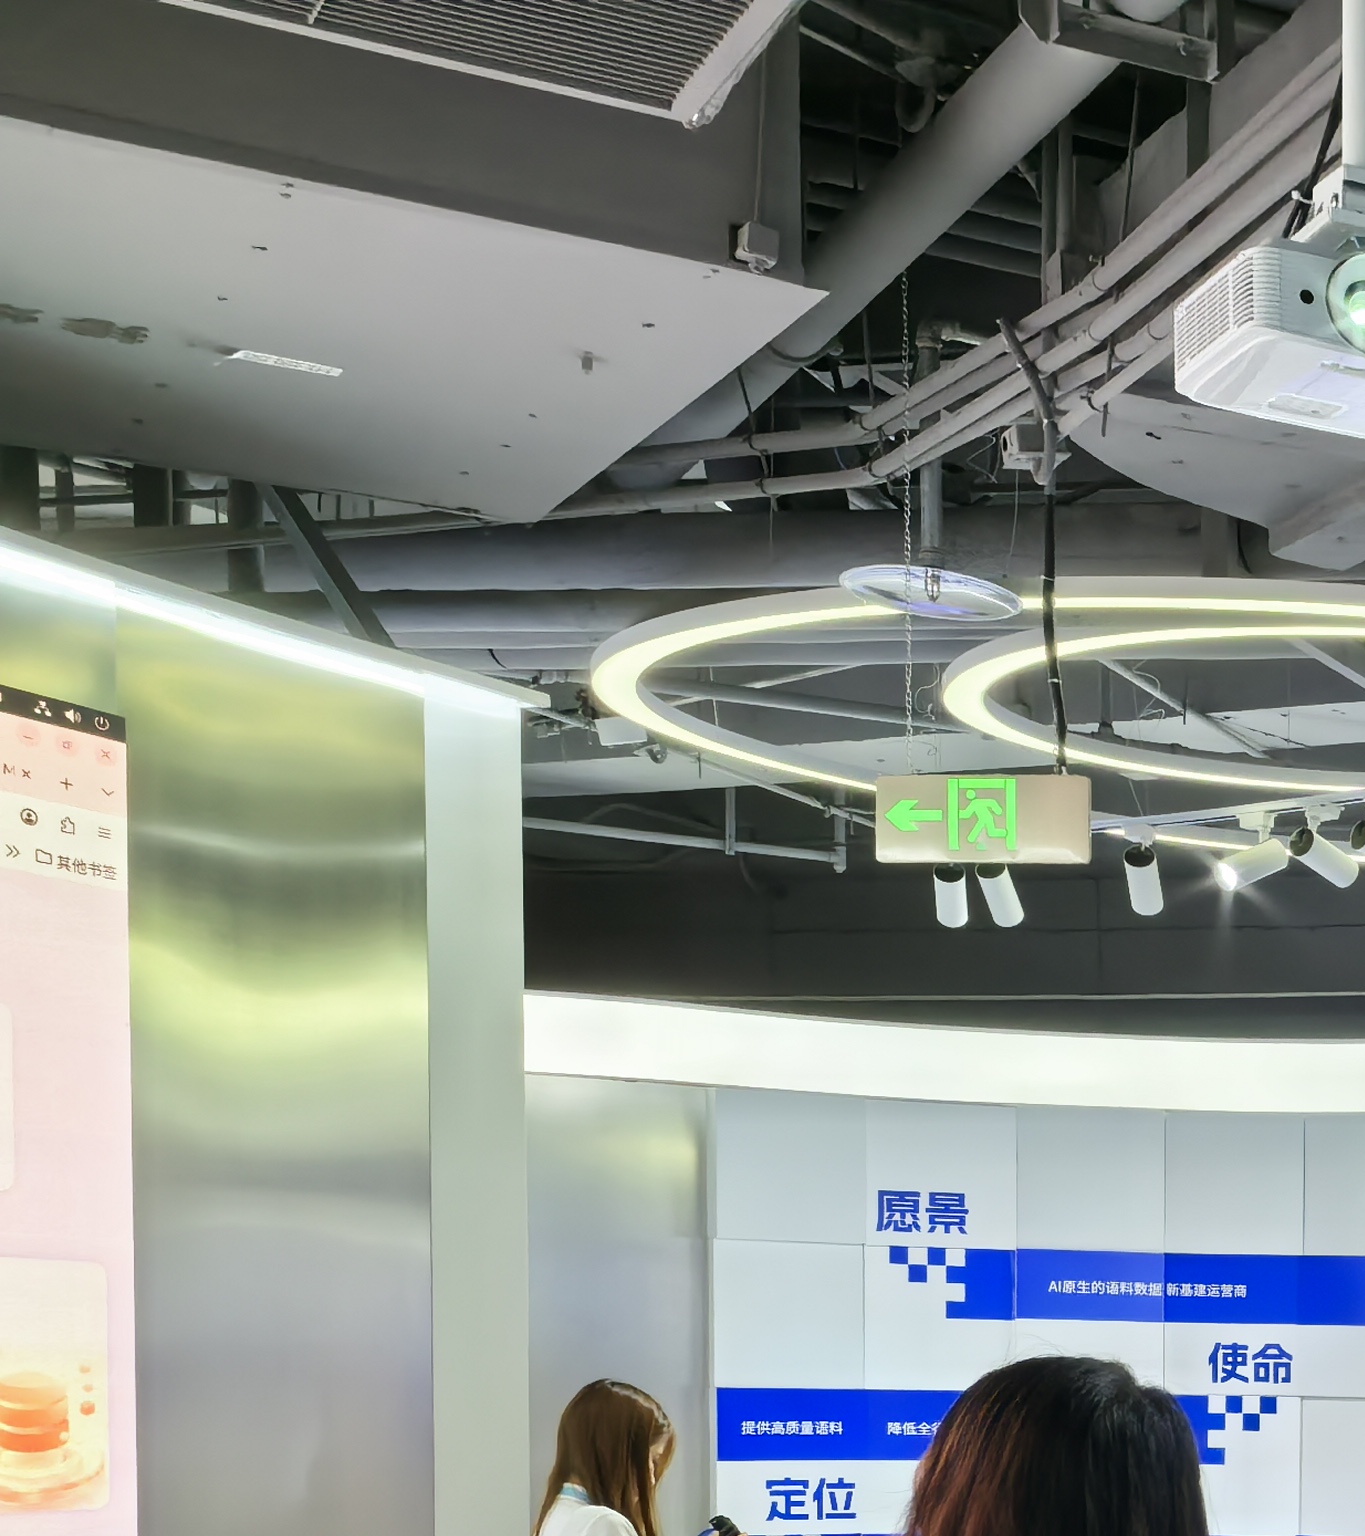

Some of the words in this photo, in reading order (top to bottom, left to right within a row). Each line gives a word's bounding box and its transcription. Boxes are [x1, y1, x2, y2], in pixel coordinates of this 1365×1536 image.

[56, 854, 118, 881] 其他书签
[876, 1189, 970, 1235] 愿景
[1208, 1342, 1293, 1384] 使命
[741, 1420, 844, 1436] 提供高质量语料
[765, 1477, 858, 1521] 定位
